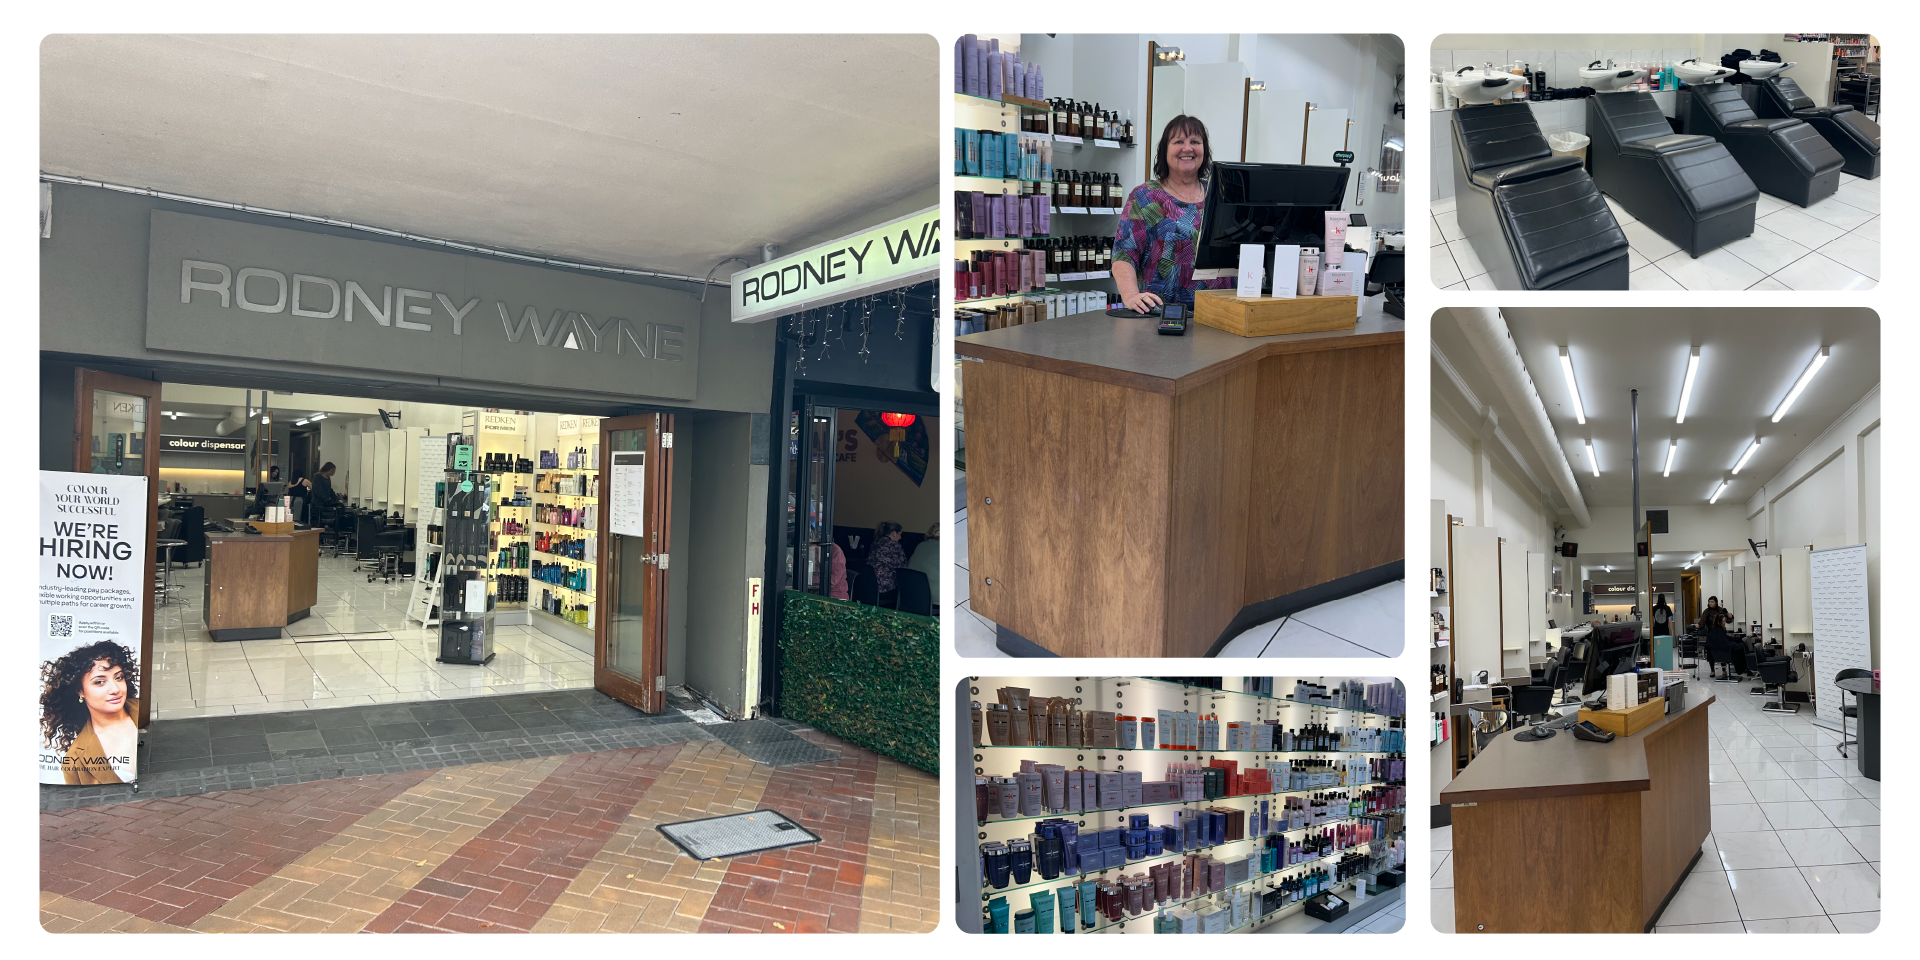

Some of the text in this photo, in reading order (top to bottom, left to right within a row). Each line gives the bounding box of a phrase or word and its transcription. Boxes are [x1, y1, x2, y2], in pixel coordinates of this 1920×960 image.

[742, 239, 874, 307] RODNEY
[180, 258, 685, 363] RODNEY WAYNE
[484, 415, 516, 424] REDKEN
[559, 419, 578, 430] REDKEN
[582, 417, 599, 428] REDKE
[169, 439, 246, 450] colour dispensar
[67, 484, 108, 495] COLOUR
[55, 494, 120, 506] YOUR WORLD
[57, 504, 116, 516] SUCCESSFUL
[54, 521, 118, 540] WE'RE
[39, 537, 132, 561] HIRING
[57, 563, 113, 581] NOW!
[80, 594, 122, 602] opportunities
[83, 756, 130, 765] WAYNE
